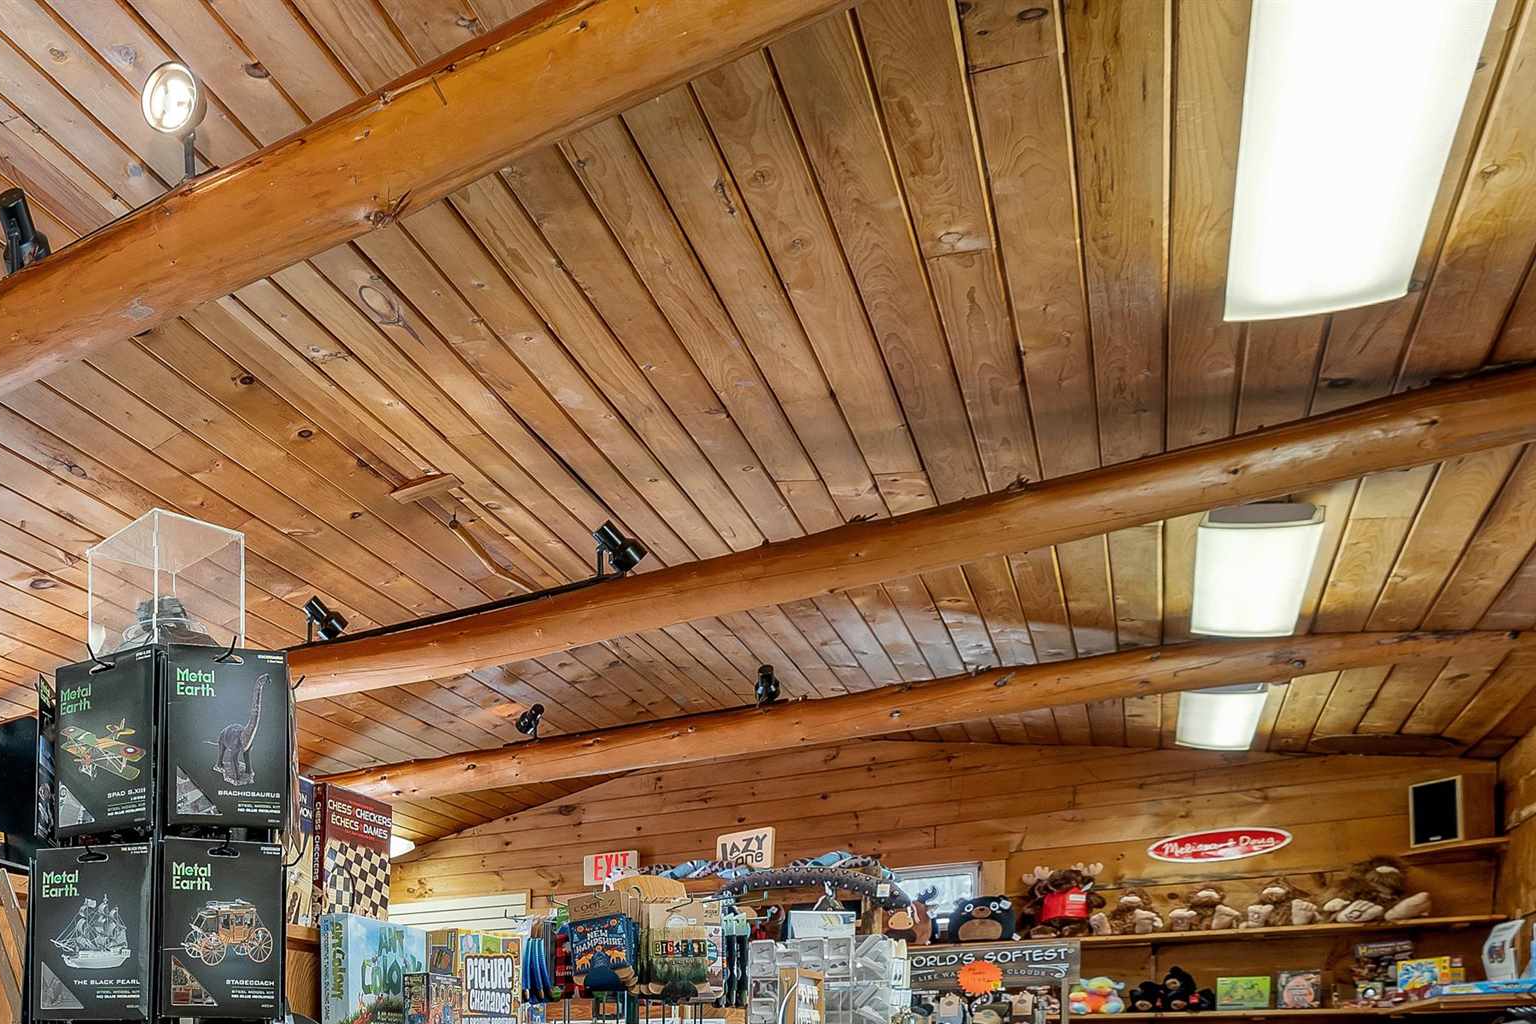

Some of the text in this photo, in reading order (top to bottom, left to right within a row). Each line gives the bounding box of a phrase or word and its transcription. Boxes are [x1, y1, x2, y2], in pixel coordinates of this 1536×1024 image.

[177, 667, 215, 683] Metal
[60, 683, 92, 702] Metal
[177, 682, 215, 697] Earth
[60, 699, 91, 716] Earth
[218, 790, 281, 799] BRACHIOSAURUS
[327, 799, 352, 816] CHESS
[355, 808, 392, 828] CHECKERS
[331, 811, 388, 840] ÉCHECS DAMES
[720, 833, 767, 861] LAZY
[172, 861, 211, 877] Metal
[593, 852, 629, 881] EXIT
[42, 870, 79, 884] Metal
[172, 875, 212, 891] Earth
[42, 884, 79, 898] Earth
[587, 929, 609, 940] NEW
[911, 948, 1068, 968] ORLD'S SOFTEST
